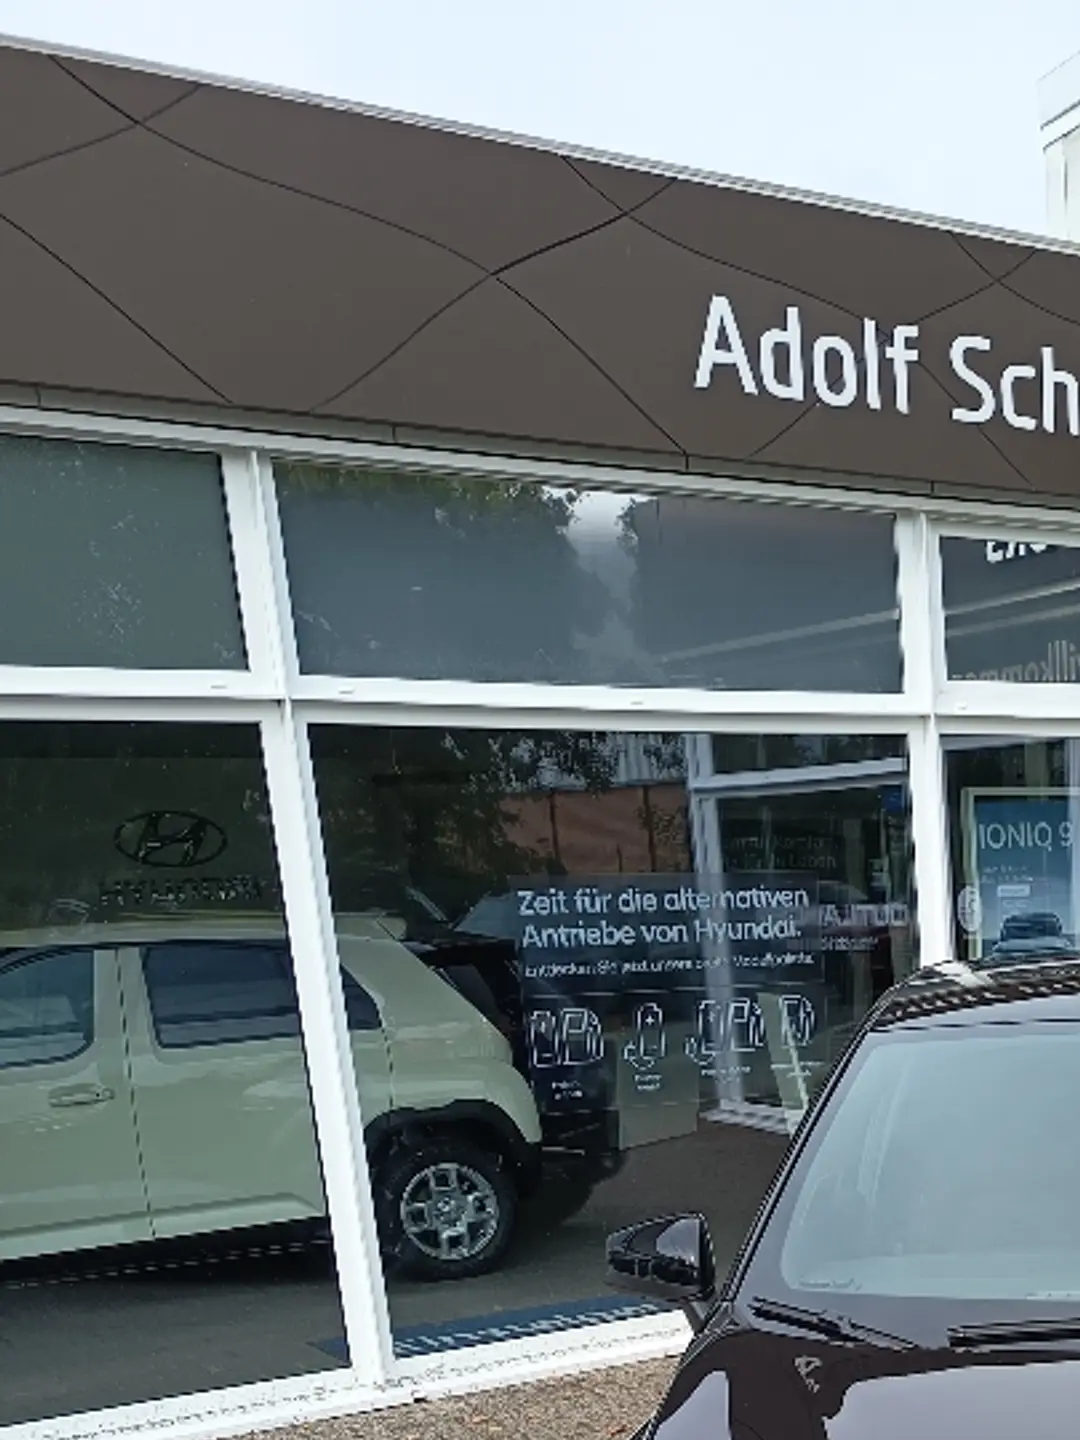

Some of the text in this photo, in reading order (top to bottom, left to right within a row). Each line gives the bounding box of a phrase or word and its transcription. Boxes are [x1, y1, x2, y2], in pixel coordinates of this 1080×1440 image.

[694, 294, 919, 414] Adolf
[980, 821, 1052, 851] IONIQ
[517, 885, 809, 916] Zeit für die alternativen
[522, 919, 636, 948] Antriebe
[641, 924, 686, 944] von
[695, 914, 802, 944] Hyundai.
